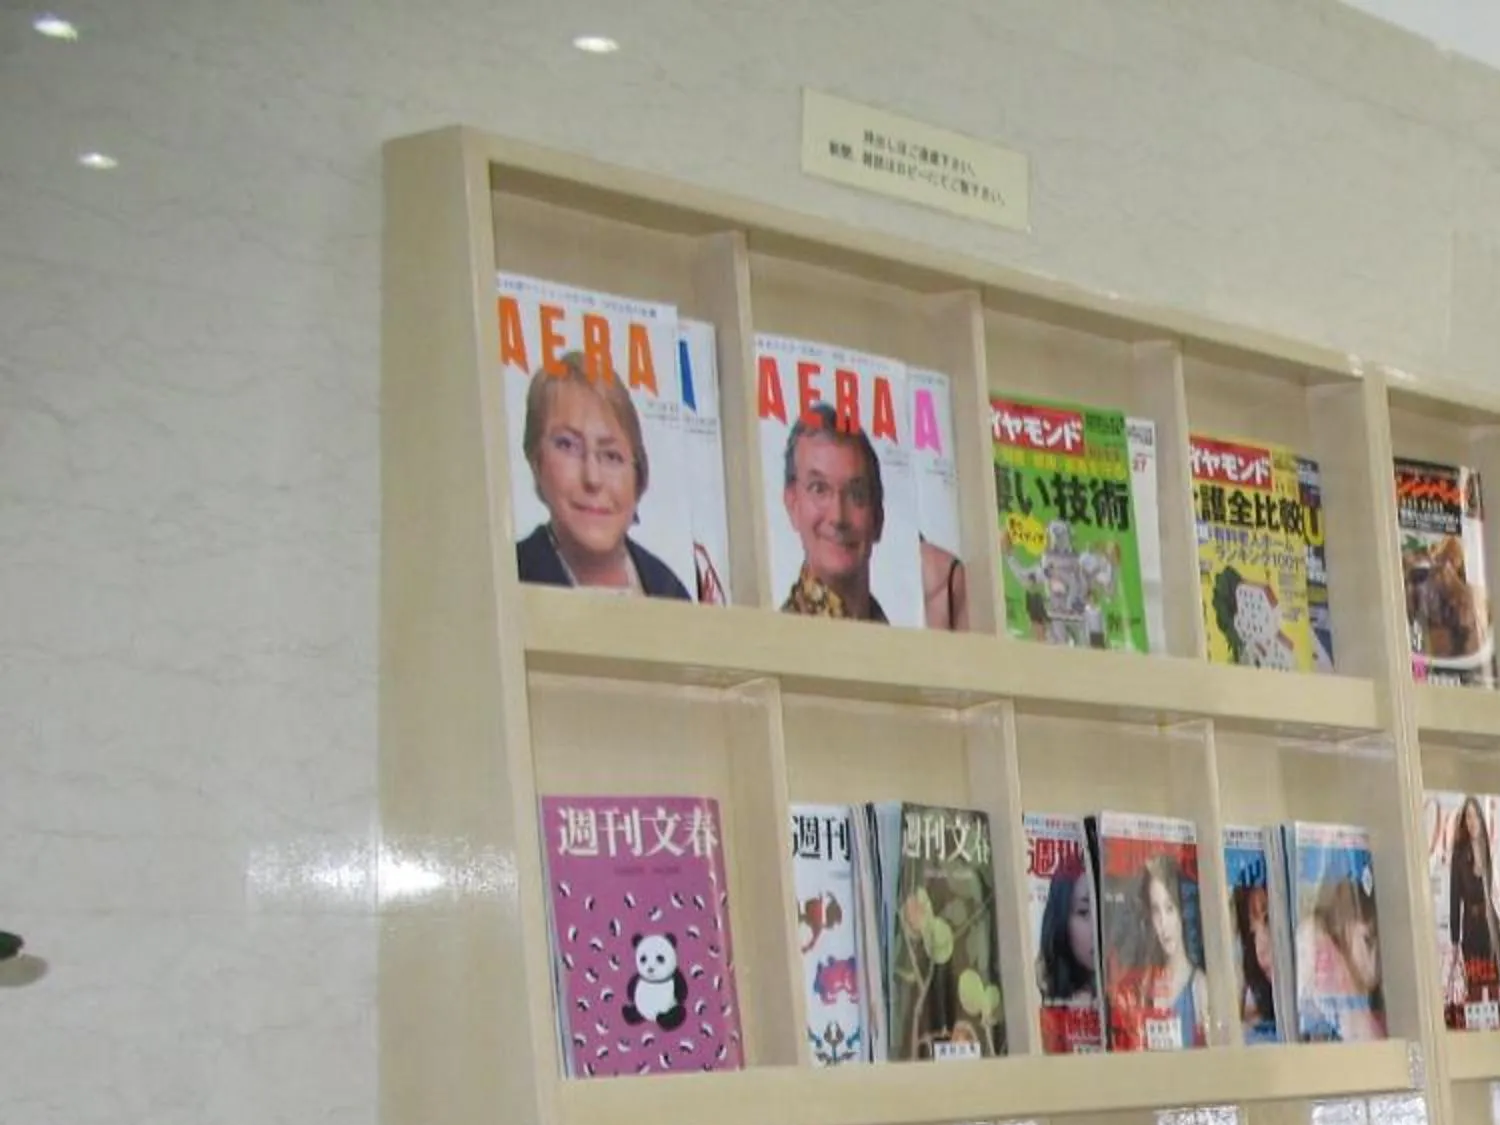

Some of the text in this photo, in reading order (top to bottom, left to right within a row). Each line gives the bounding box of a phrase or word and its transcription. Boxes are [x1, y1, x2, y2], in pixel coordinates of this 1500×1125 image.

[497, 295, 660, 398] AERA
[756, 356, 900, 445] AERA
[557, 806, 720, 857] 週刊文春
[792, 814, 851, 862] 週刊
